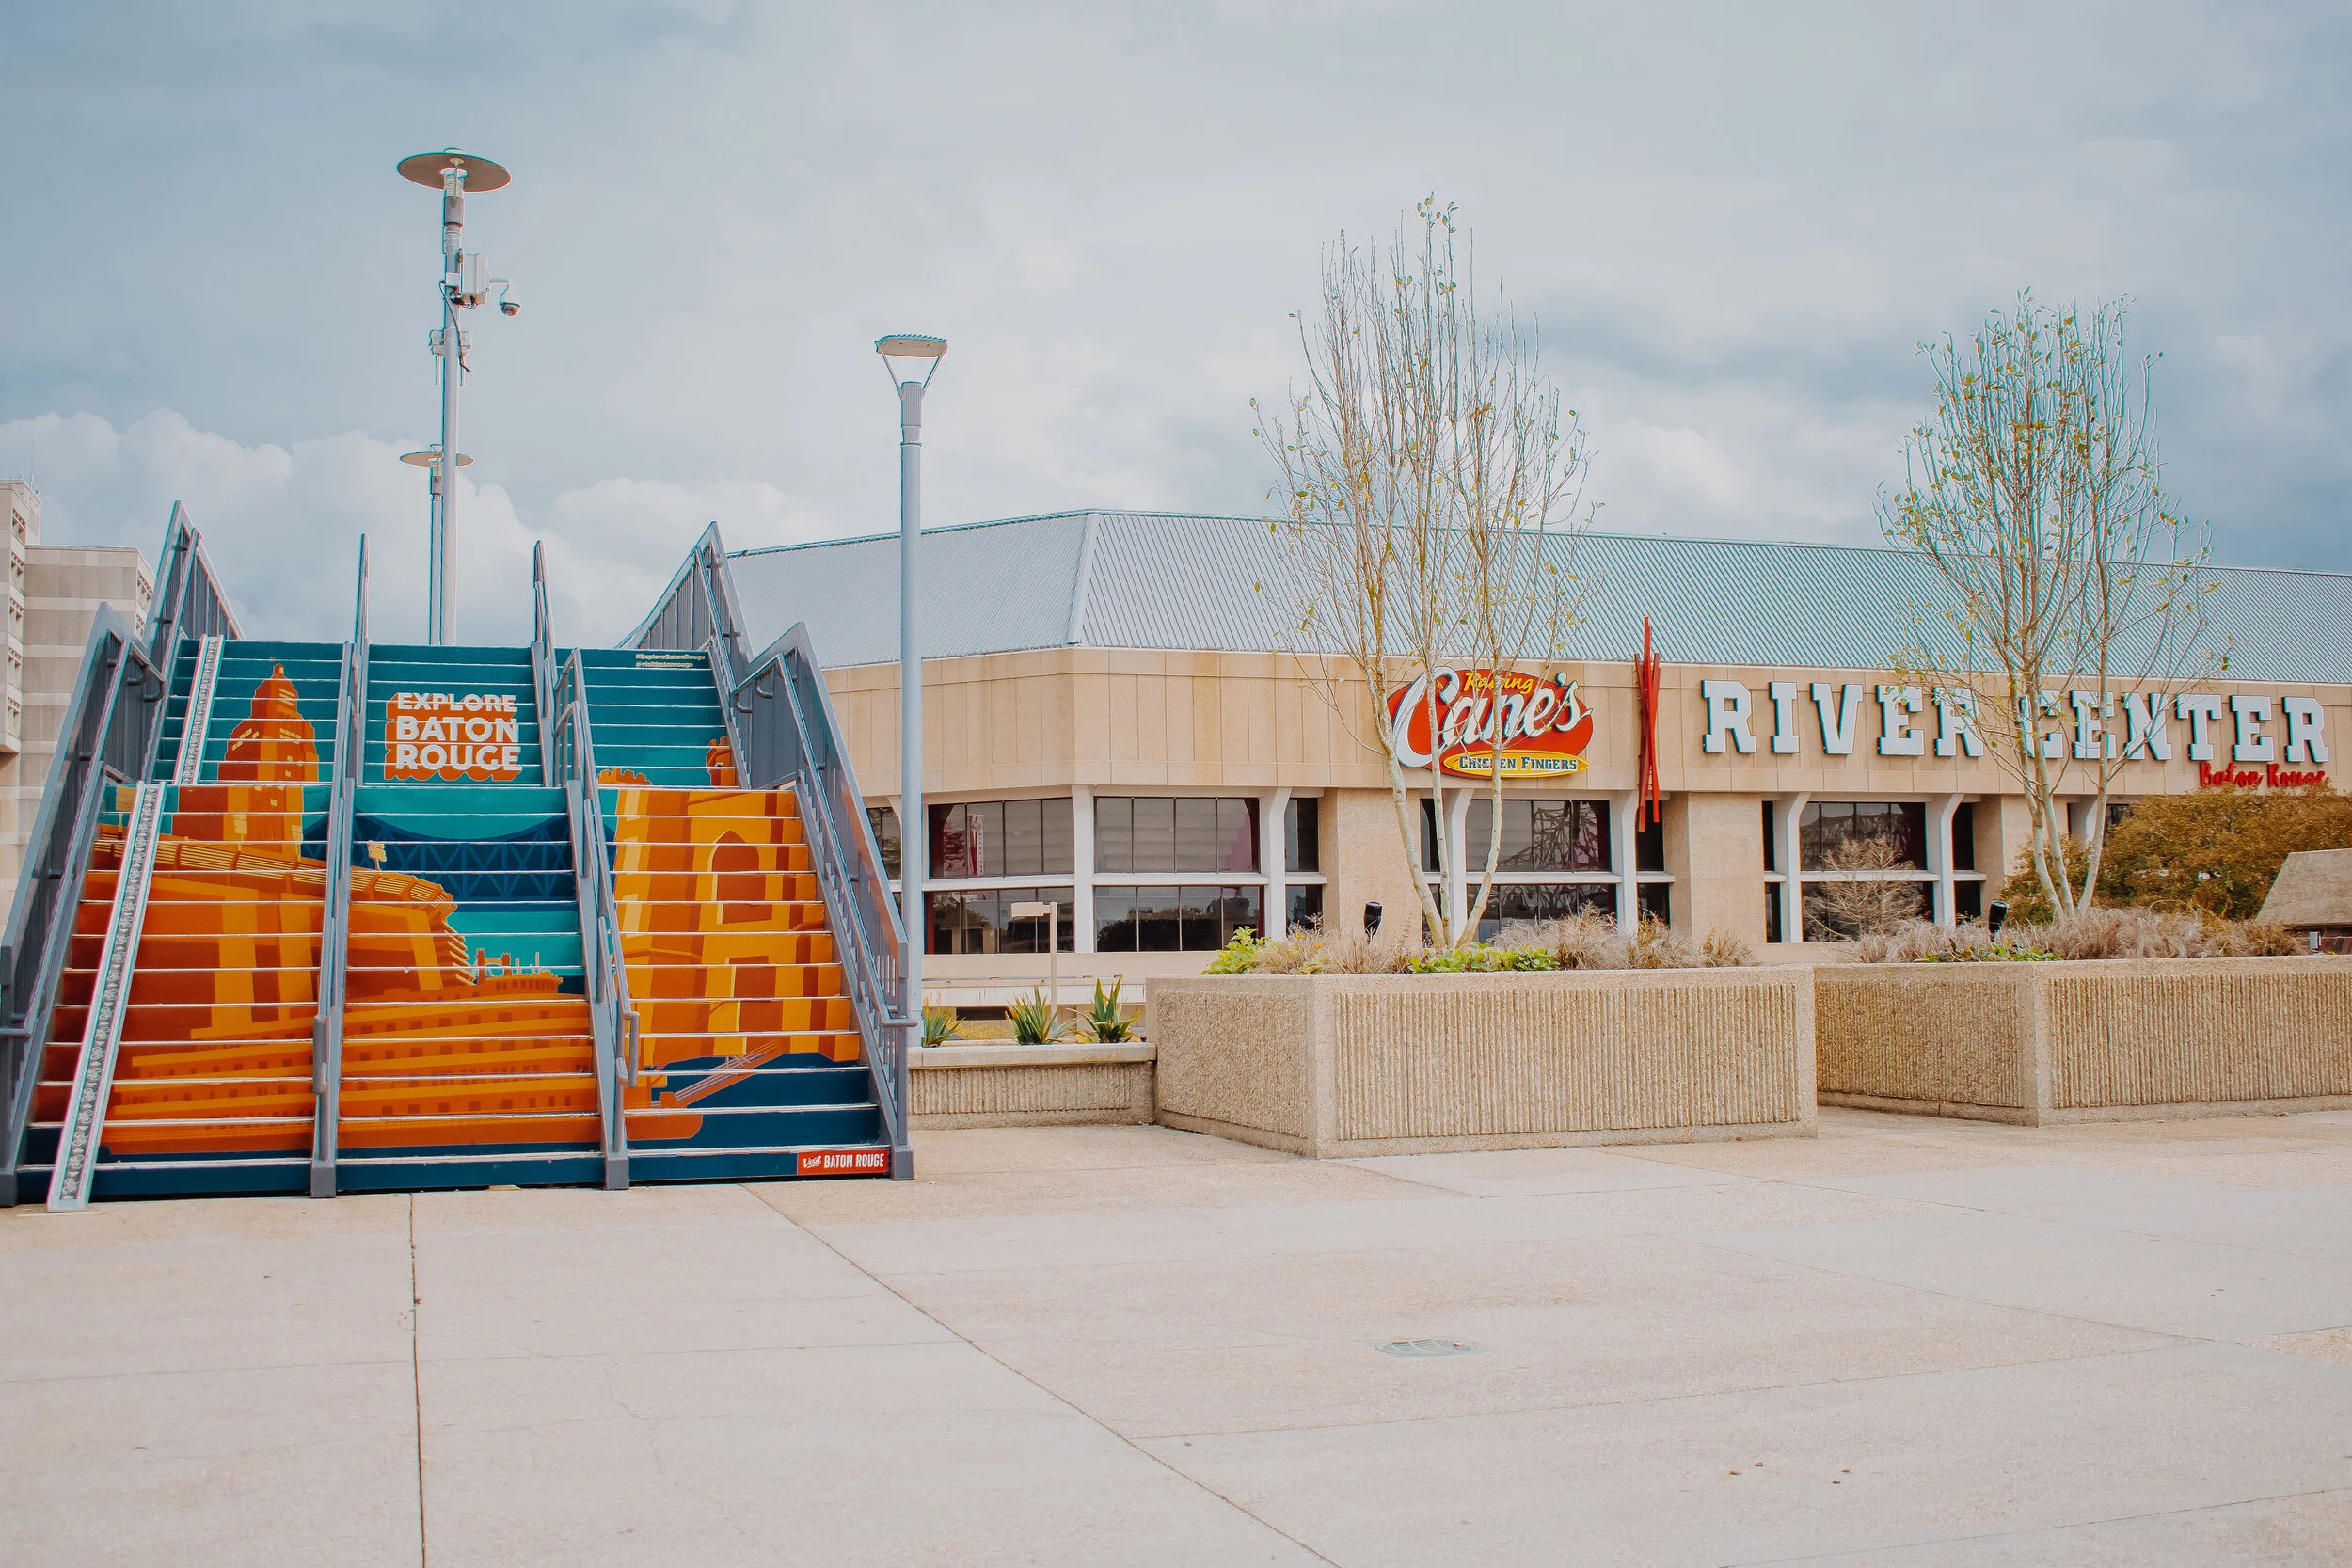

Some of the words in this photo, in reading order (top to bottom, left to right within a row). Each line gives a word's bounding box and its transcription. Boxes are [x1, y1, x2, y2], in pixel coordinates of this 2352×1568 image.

[1463, 672, 1534, 695] Raiing
[396, 692, 517, 713] EXPLORE
[395, 715, 518, 743] BATON
[1392, 665, 1594, 768] Cane's
[1701, 679, 1984, 757] RIVER
[2020, 689, 2329, 763] CENTER
[395, 744, 523, 771] ROUGE
[1458, 755, 1518, 770] CHICEN
[1520, 756, 1579, 770] FINGERS
[2199, 761, 2264, 788] Baton
[803, 1155, 822, 1169] Visit
[823, 1154, 853, 1169] BATON
[855, 1153, 885, 1168] ROUGE
